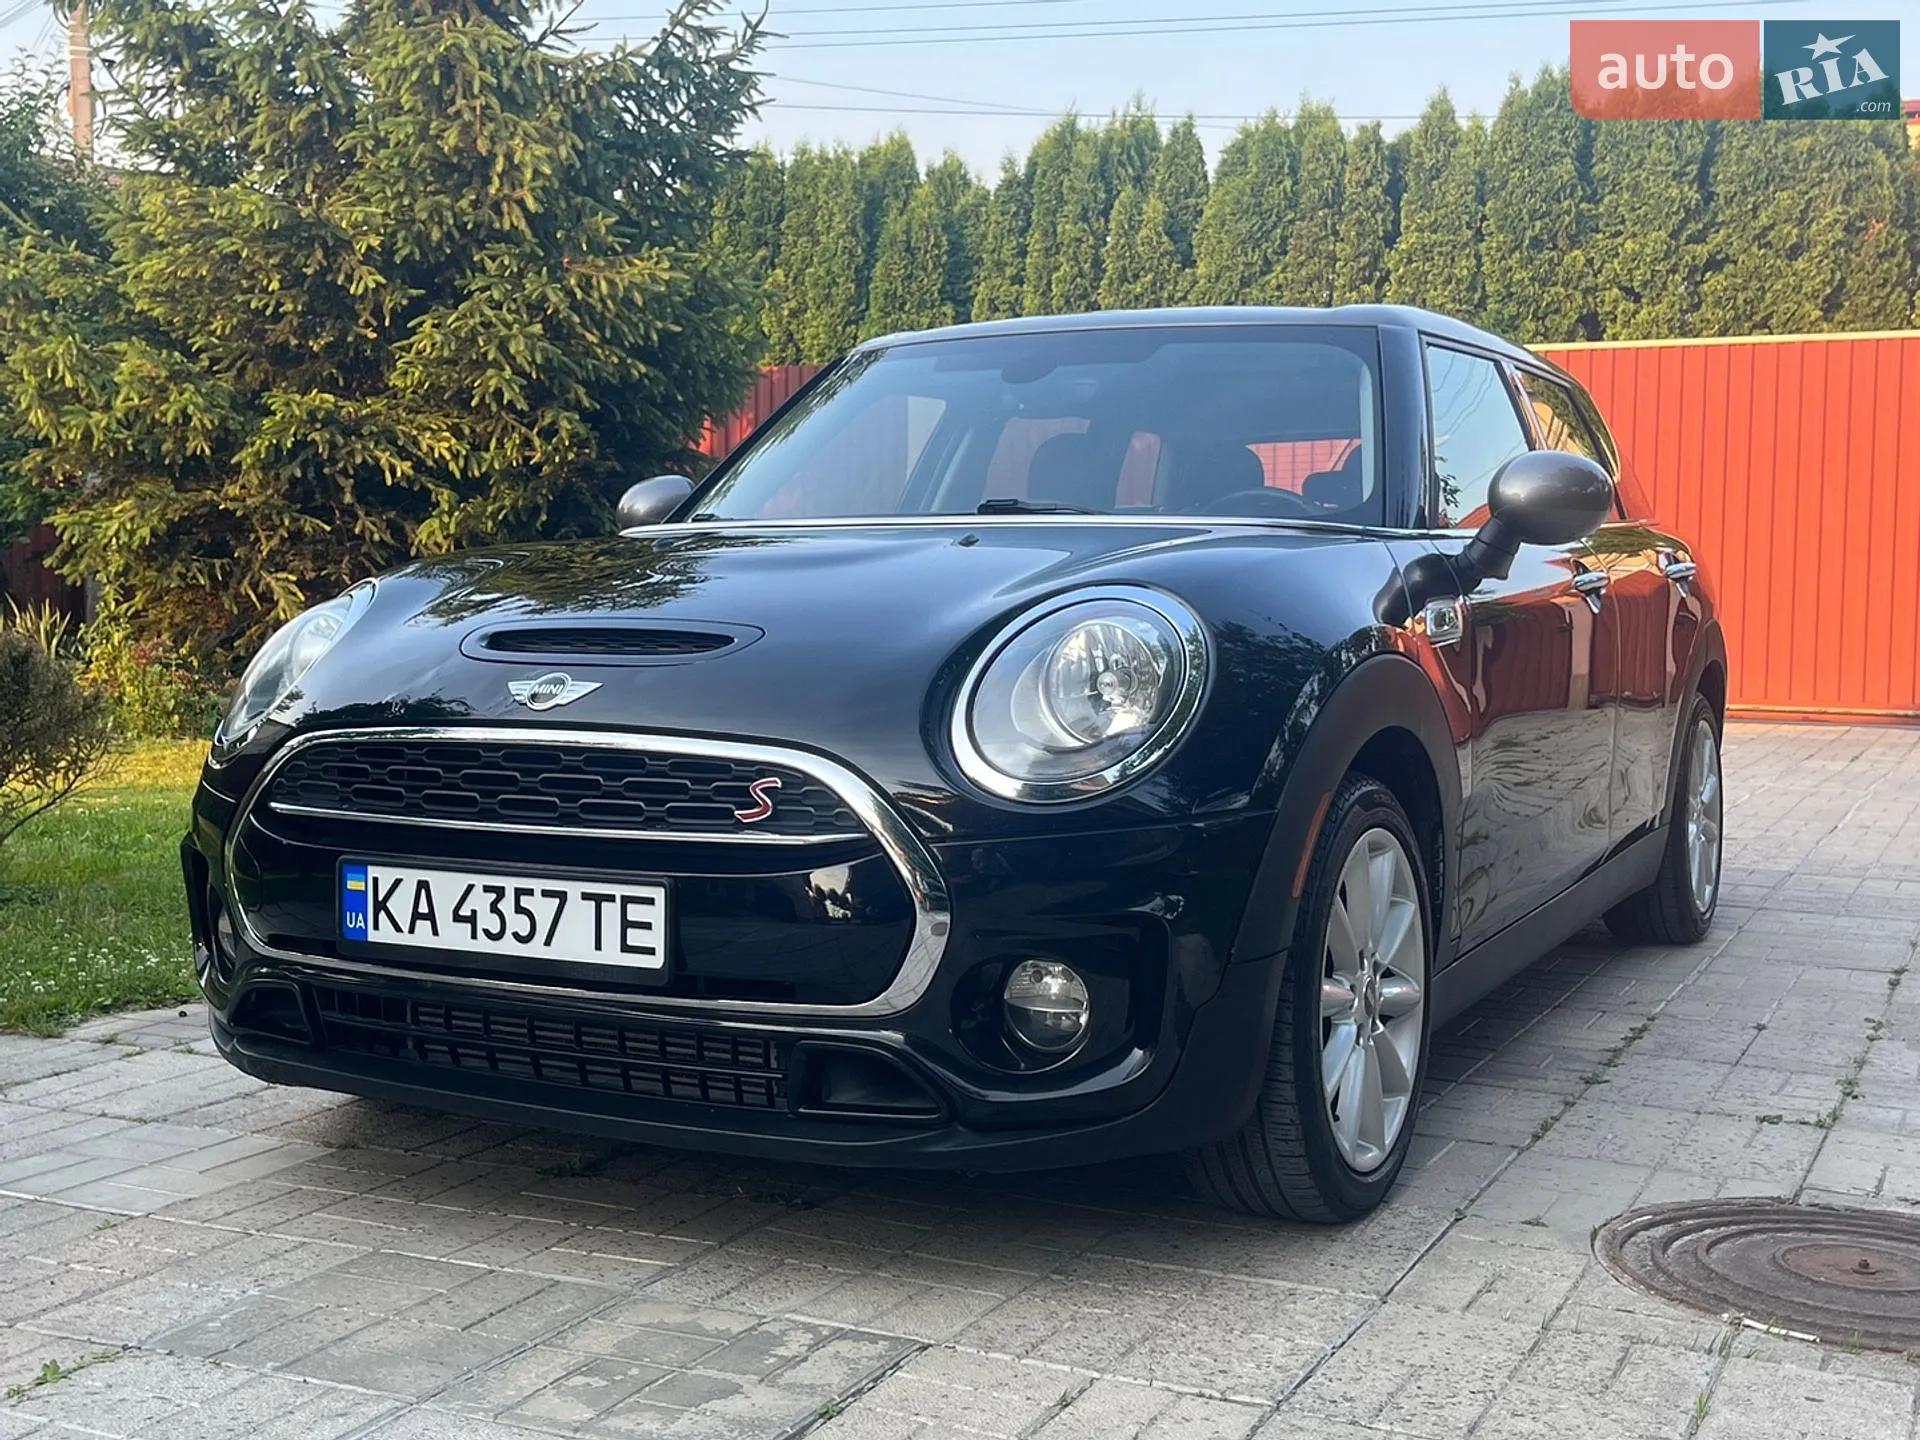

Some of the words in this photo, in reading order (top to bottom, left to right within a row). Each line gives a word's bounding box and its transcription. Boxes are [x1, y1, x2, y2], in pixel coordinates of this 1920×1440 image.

[531, 684, 564, 695] MINI
[734, 777, 782, 823] S
[347, 912, 366, 930] UA
[372, 876, 440, 937] KA
[452, 883, 568, 947] 4357
[581, 891, 656, 956] TE
